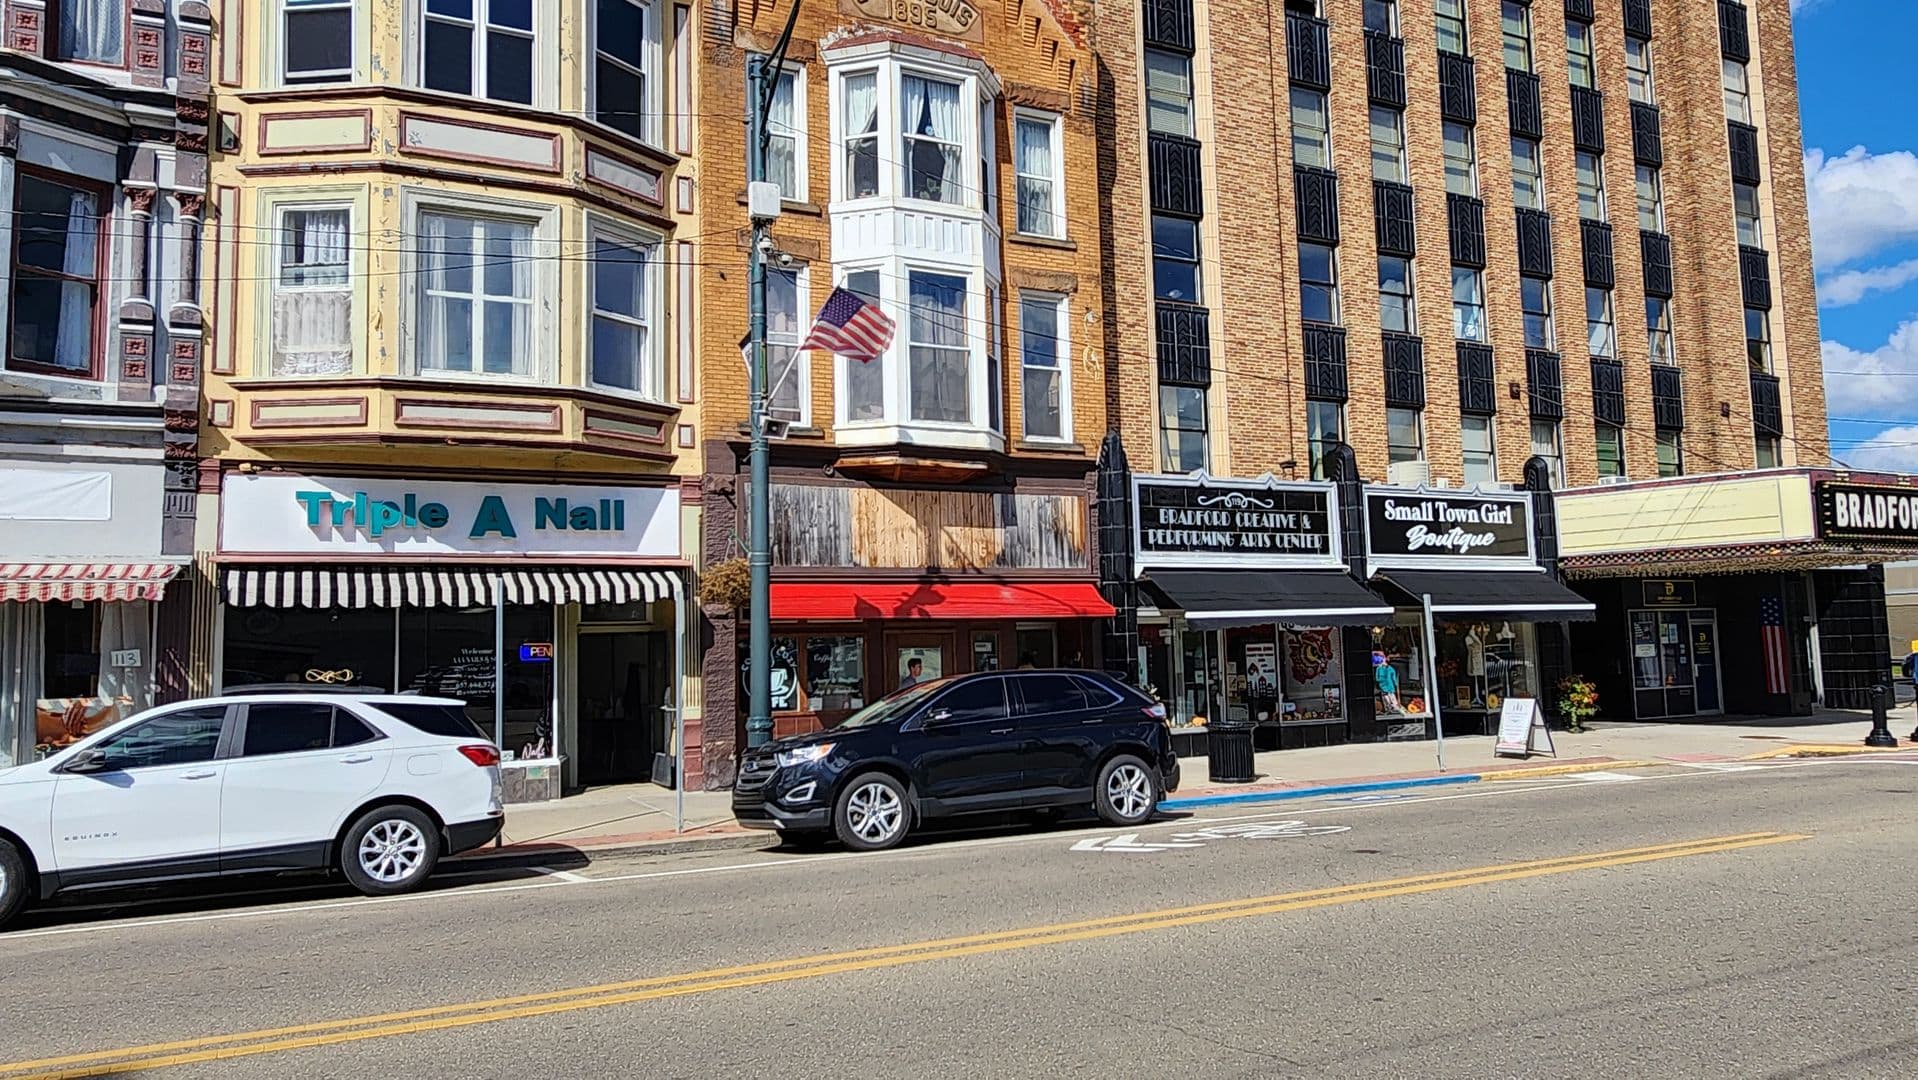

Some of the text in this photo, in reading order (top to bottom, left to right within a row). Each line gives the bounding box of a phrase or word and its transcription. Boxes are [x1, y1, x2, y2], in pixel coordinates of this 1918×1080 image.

[888, 0, 937, 28] 1895
[469, 495, 517, 538] A
[1159, 508, 1311, 529] BRADFORD CREATIVE &
[1384, 499, 1513, 524] Small Town Girl
[1148, 529, 1322, 549] PERFORMING ARTS CENTER
[1406, 525, 1495, 553] Boutique
[114, 652, 137, 665] 113
